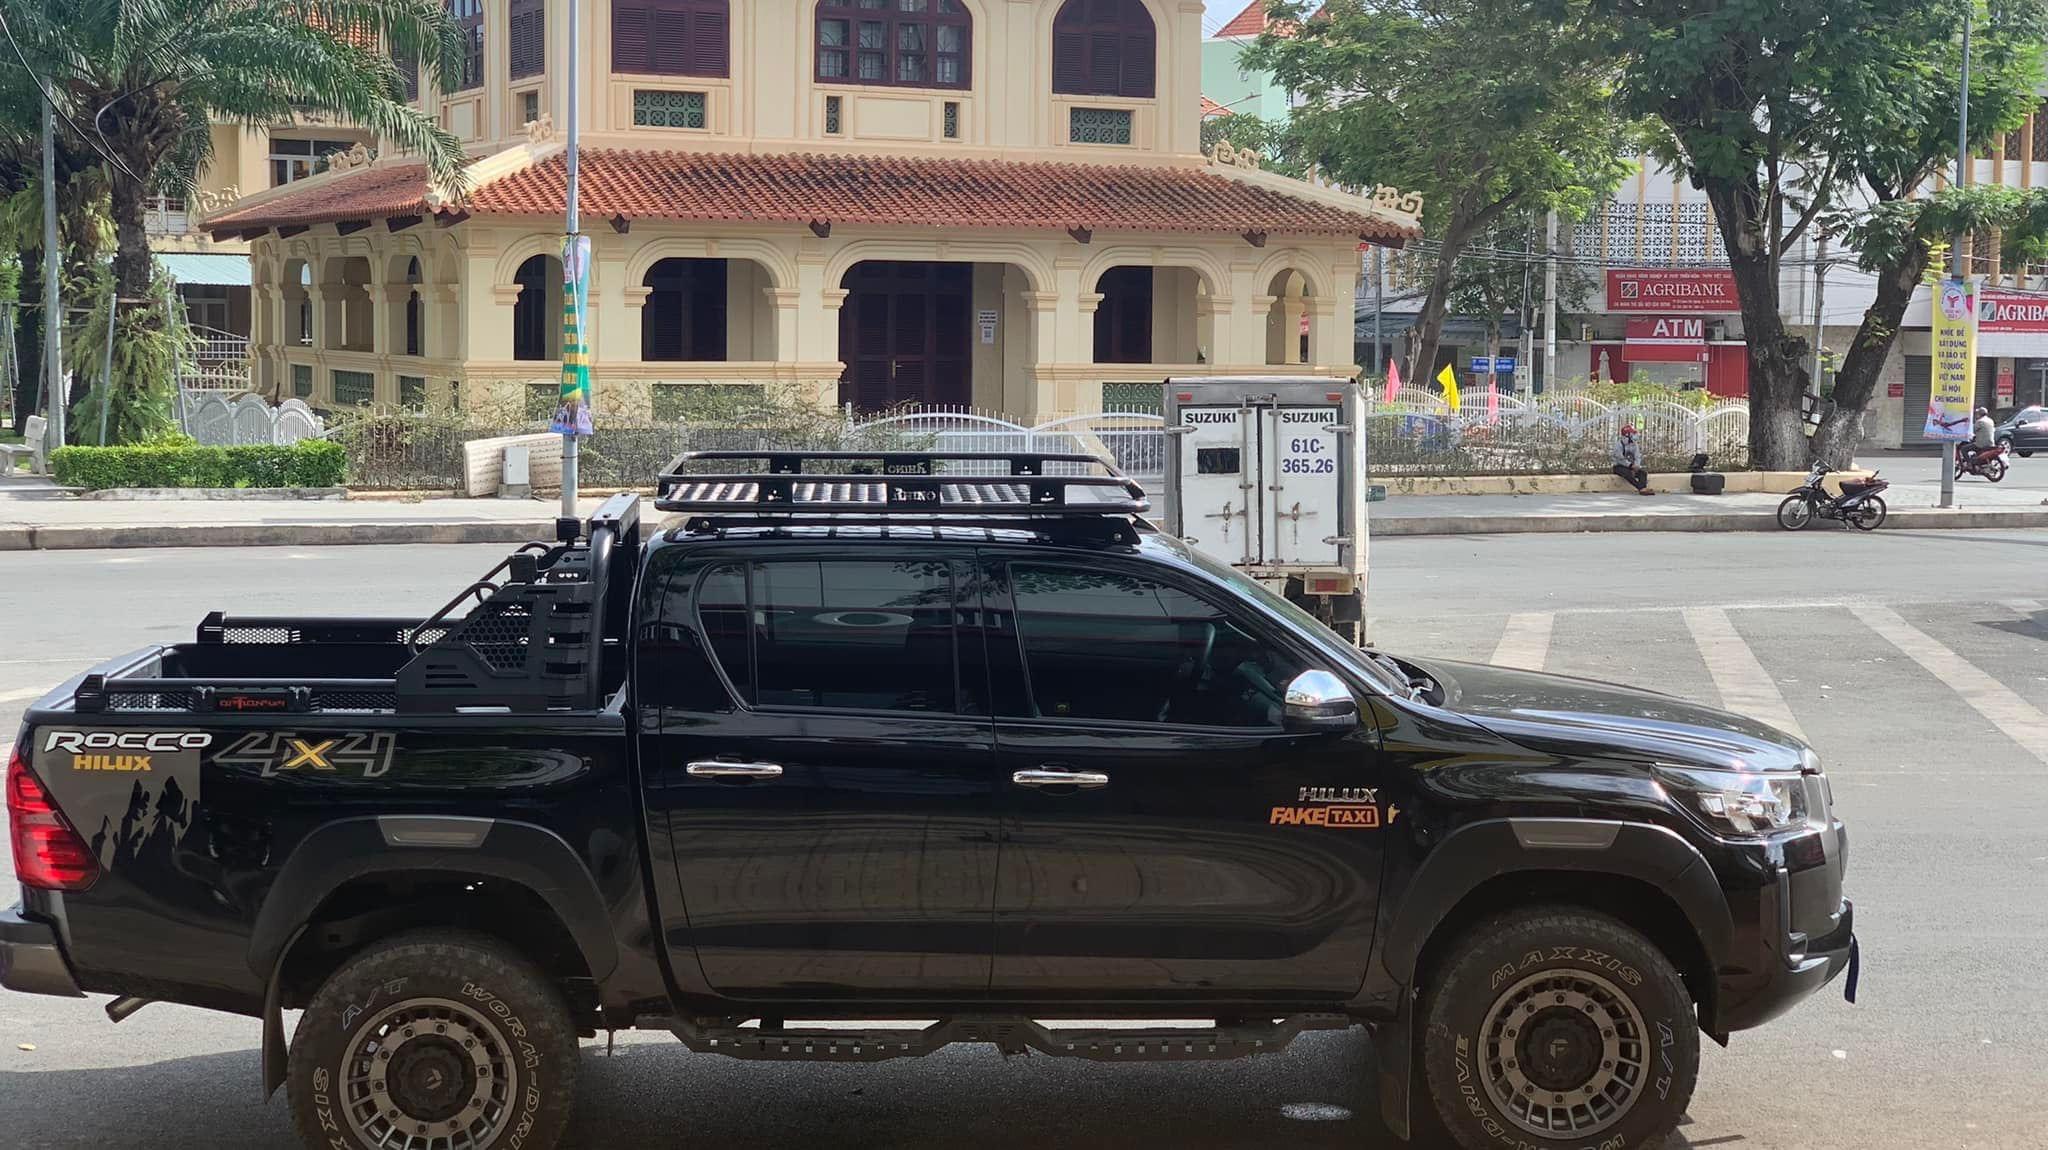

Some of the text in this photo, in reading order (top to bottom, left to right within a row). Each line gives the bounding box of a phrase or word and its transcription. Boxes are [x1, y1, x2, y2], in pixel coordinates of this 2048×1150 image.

[1643, 284, 1724, 296] AGRIBANK
[1652, 319, 1702, 337] ATM
[1185, 412, 1237, 424] SUZUKI
[1282, 412, 1334, 424] SUZUKI
[1291, 438, 1325, 454] 61C-
[1282, 458, 1334, 474] 365.26
[44, 731, 212, 753] ROCCO
[73, 755, 152, 771] HILUX
[1298, 786, 1378, 803] HILUX
[1270, 807, 1373, 825] FAKE TAXI
[1491, 947, 1643, 990] MAXXIS
